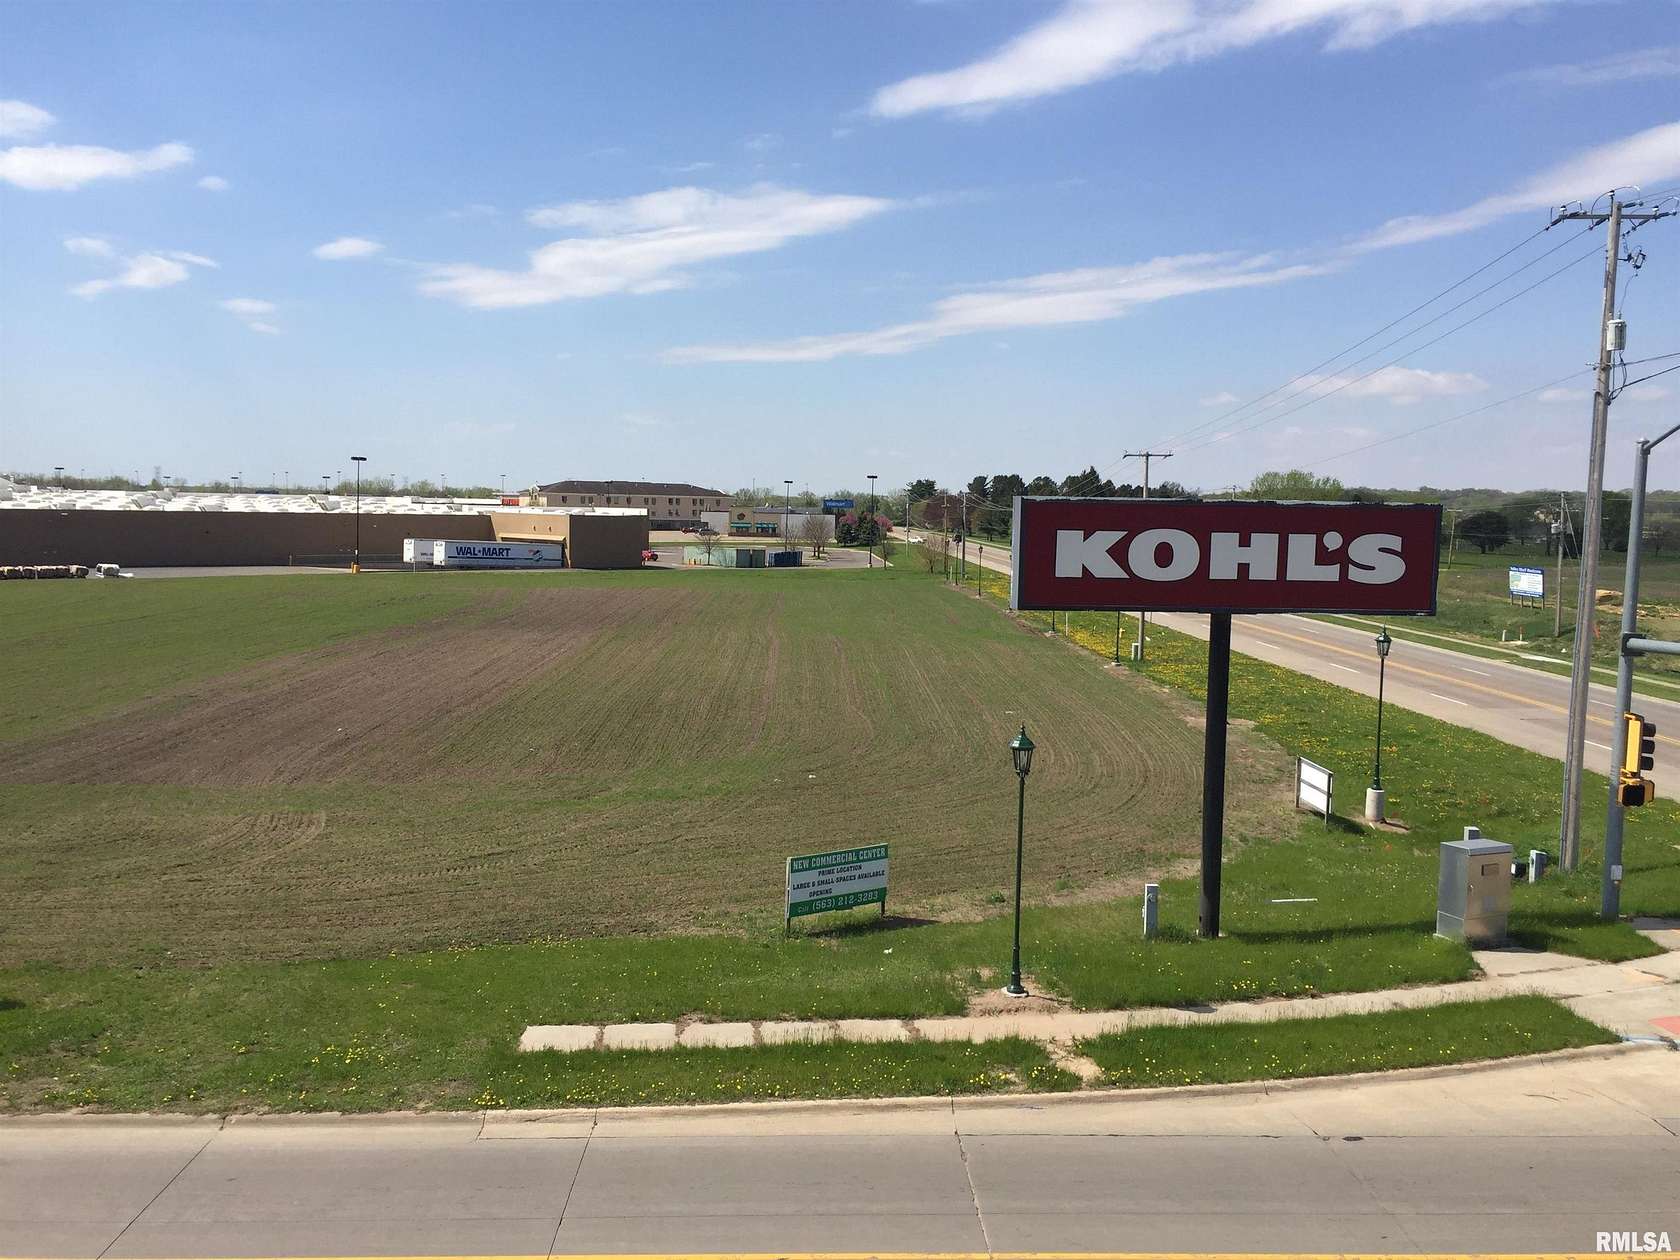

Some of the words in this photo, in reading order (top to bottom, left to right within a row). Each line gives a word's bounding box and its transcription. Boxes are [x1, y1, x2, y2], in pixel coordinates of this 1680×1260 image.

[1055, 528, 1407, 584] KOHL'S
[793, 859, 809, 870] NEW
[812, 852, 857, 866] COMMERCIAL
[859, 848, 885, 859] CENTER
[818, 868, 835, 876] PRIME
[836, 864, 862, 874] LOCATION
[792, 881, 811, 890] LARGE
[817, 877, 835, 887] SMALL
[835, 874, 857, 884] SPACES
[857, 870, 885, 879] AVAILABLE
[809, 888, 832, 898] OPENING
[812, 898, 835, 911] (563)
